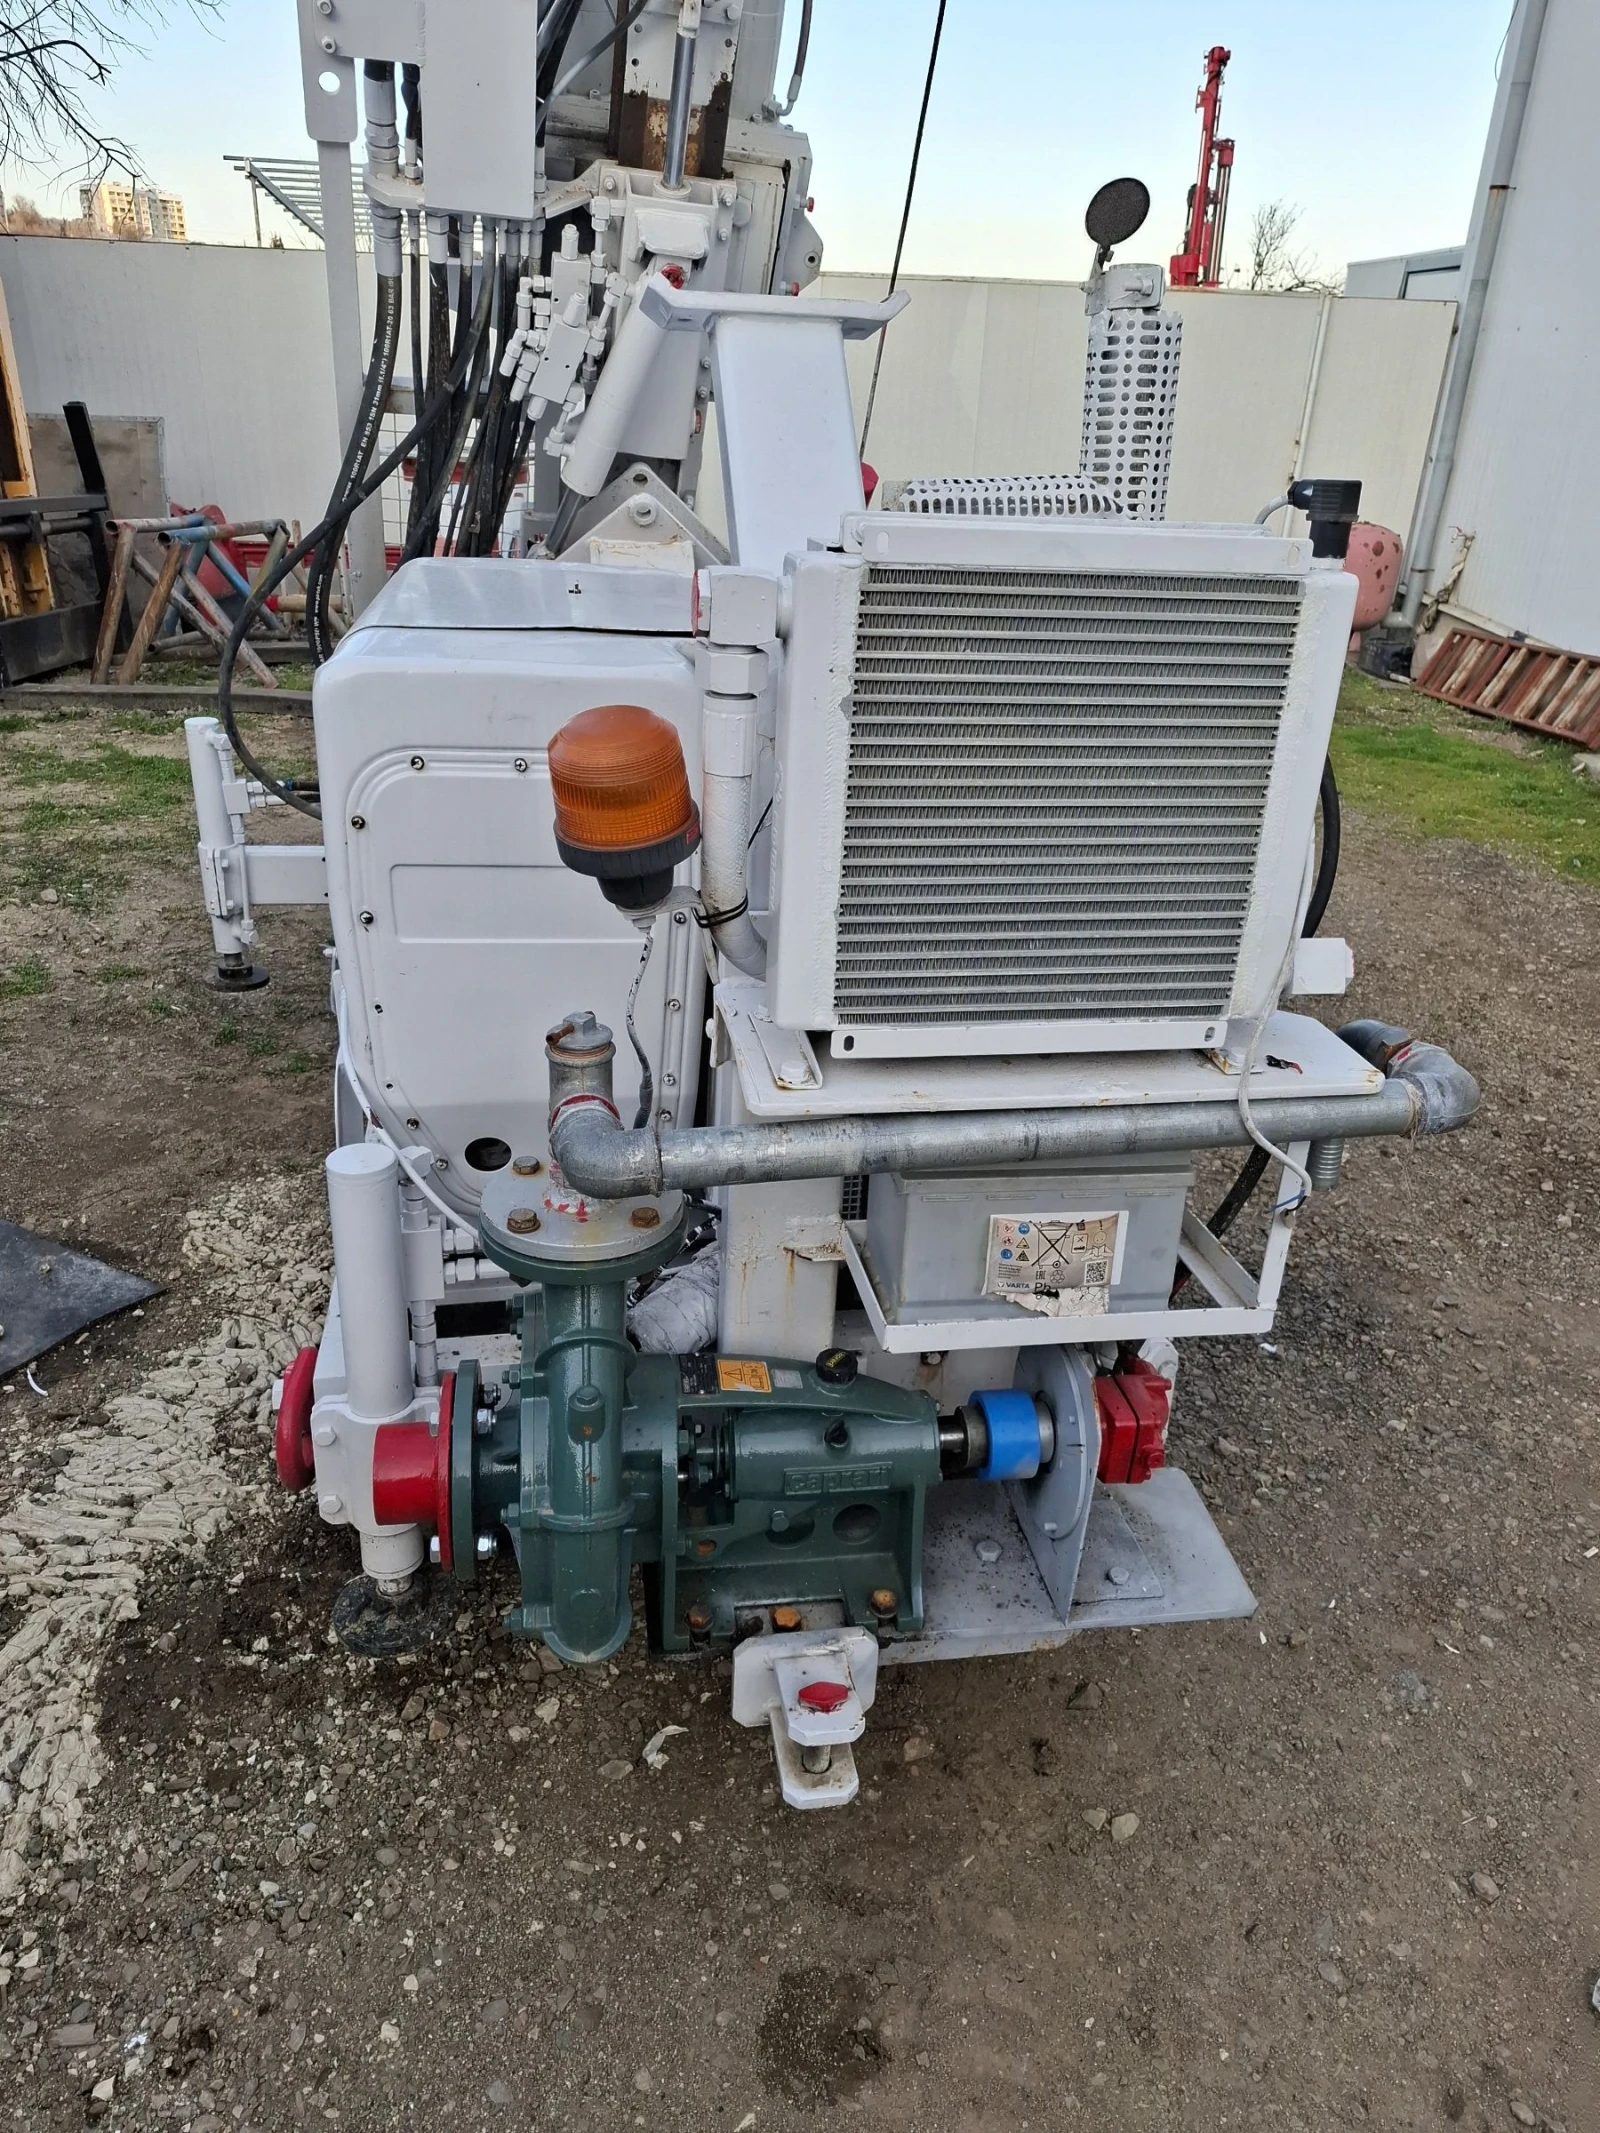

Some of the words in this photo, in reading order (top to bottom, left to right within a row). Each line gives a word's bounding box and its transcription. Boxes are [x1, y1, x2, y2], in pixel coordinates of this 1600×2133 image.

[387, 288, 395, 304] BAR
[372, 384, 383, 406] 31mm
[369, 407, 378, 421] 1SN
[361, 436, 369, 448] EN
[788, 1466, 891, 1492] caprari
